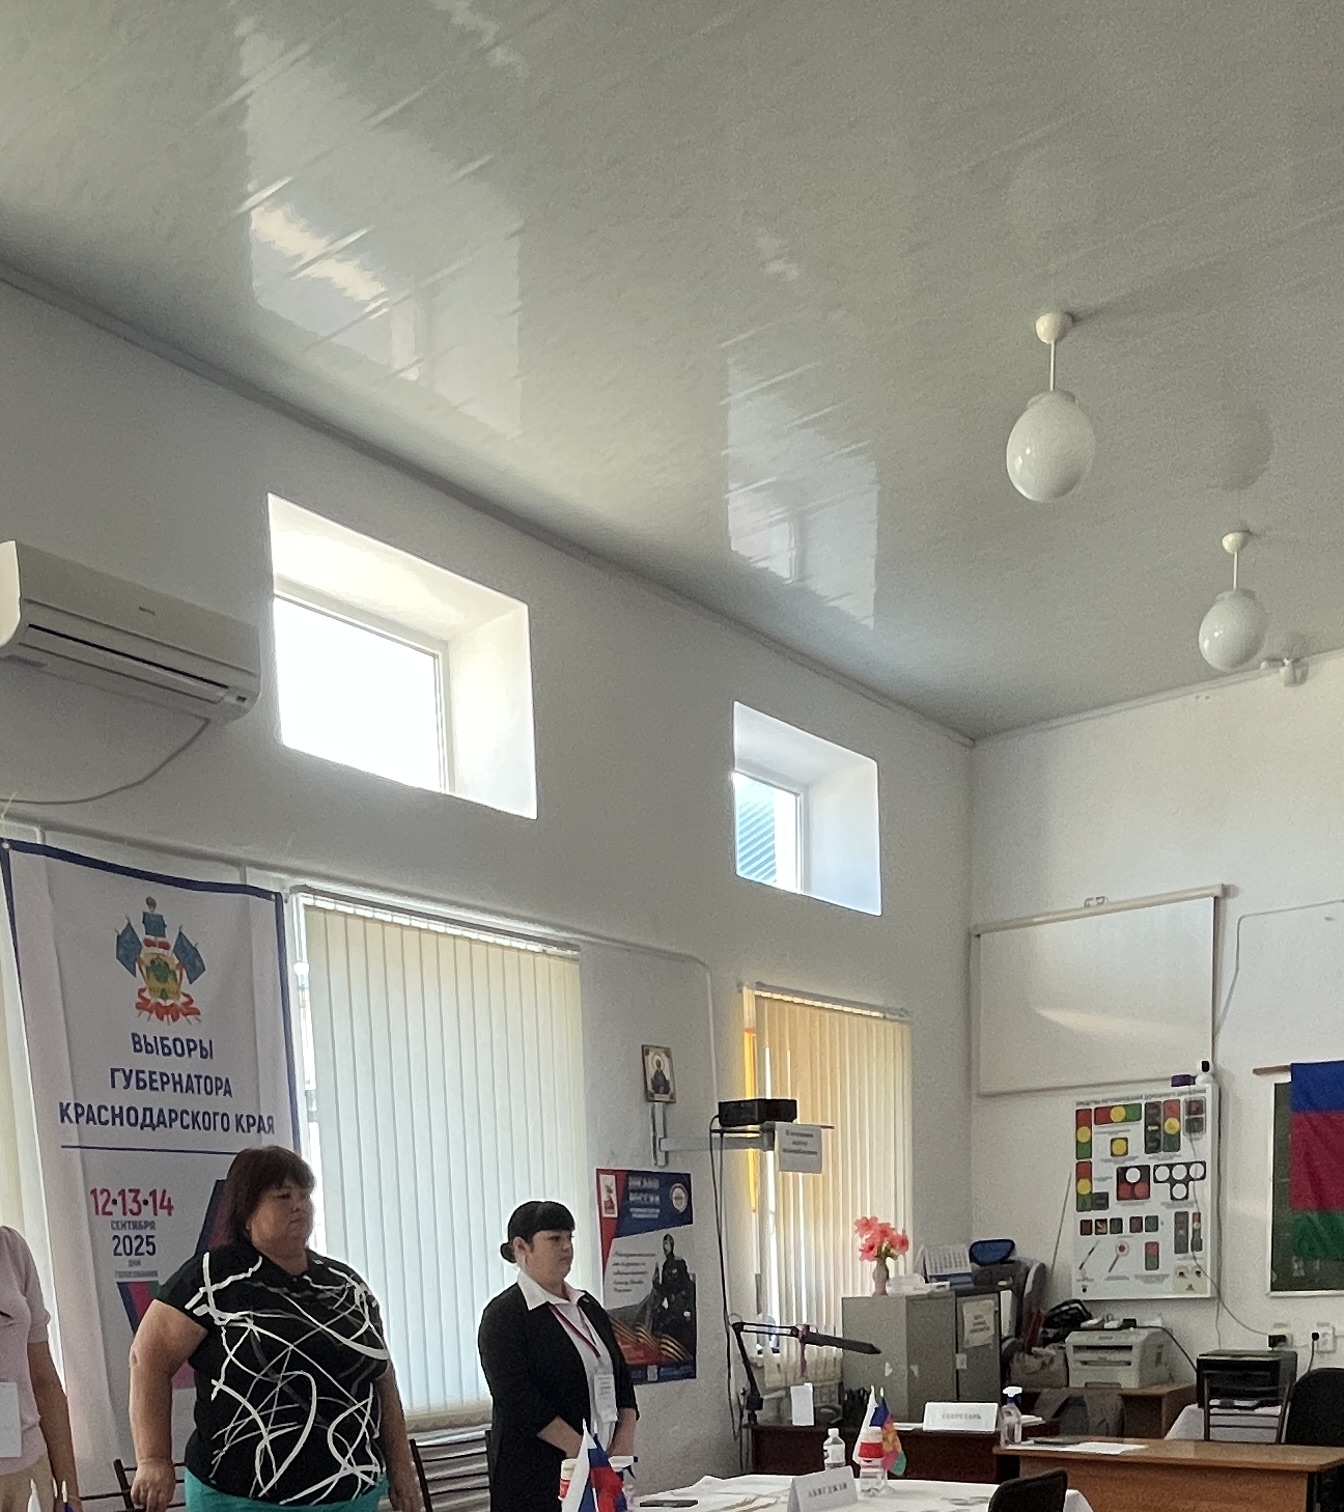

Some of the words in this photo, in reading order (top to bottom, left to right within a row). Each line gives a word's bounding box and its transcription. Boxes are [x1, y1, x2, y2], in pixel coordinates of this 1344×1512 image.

[131, 1032, 213, 1060] ВЫБОРЫ
[110, 1067, 233, 1098] ГУБЕРНАТОРА
[59, 1101, 231, 1132] КРАСНОДАРСКОГО
[235, 1114, 276, 1135] КРАЯ
[110, 1220, 156, 1231] СЕНТЯБРЯ
[112, 1234, 156, 1257] 2025
